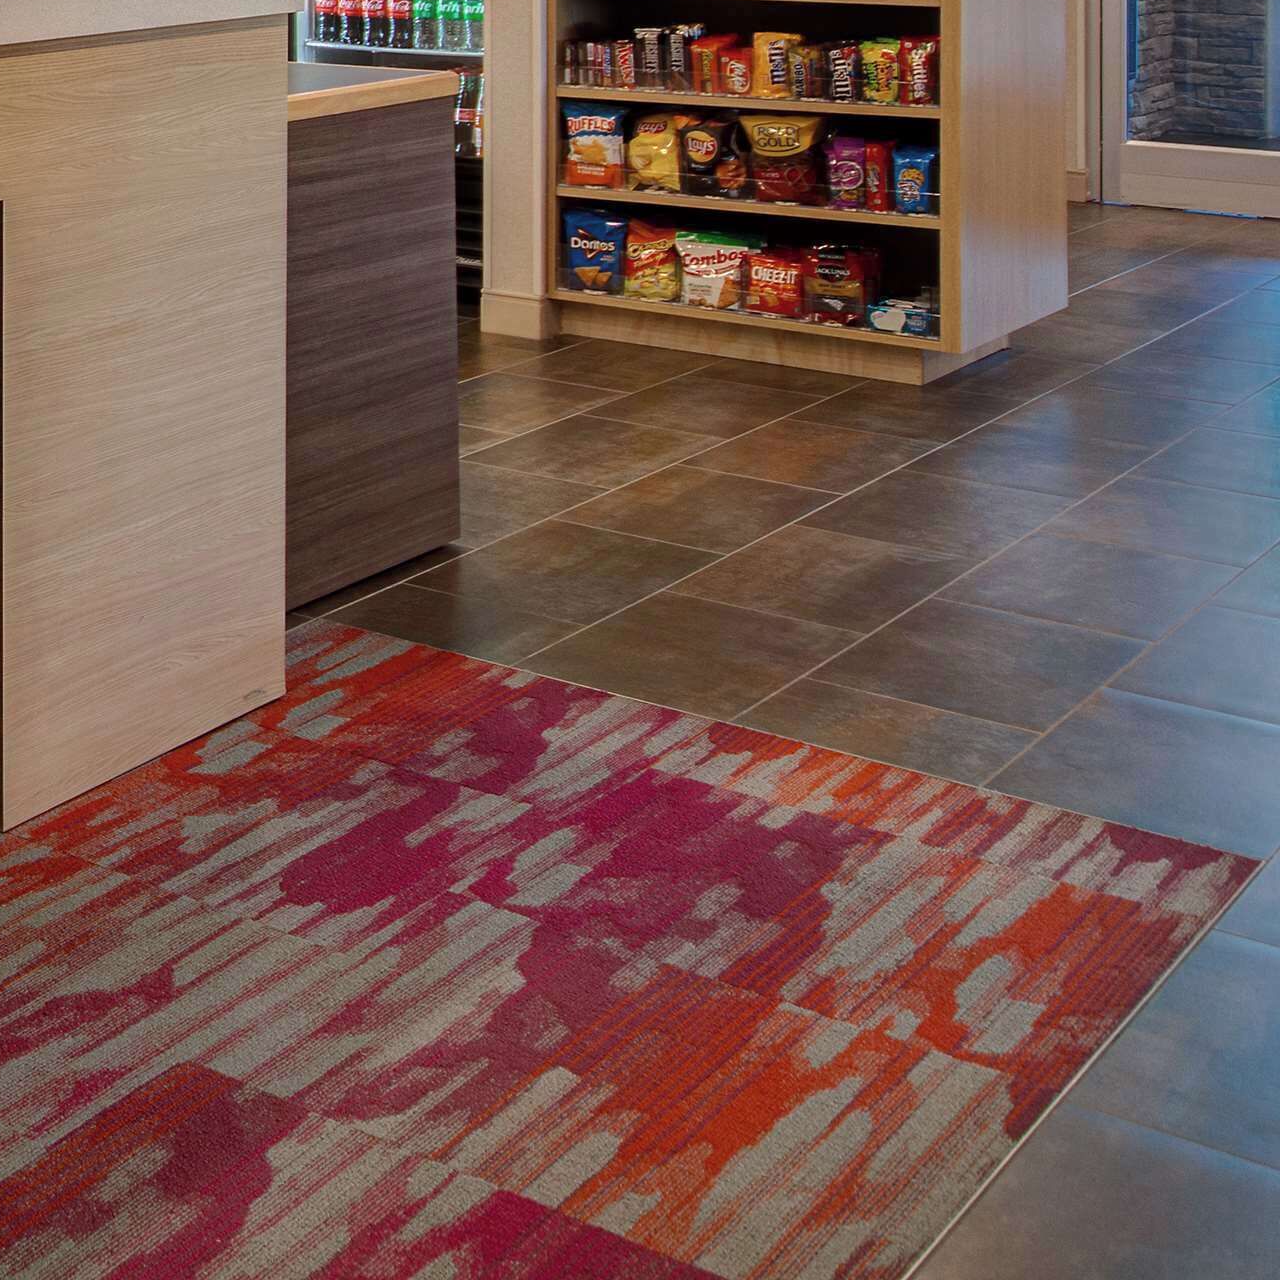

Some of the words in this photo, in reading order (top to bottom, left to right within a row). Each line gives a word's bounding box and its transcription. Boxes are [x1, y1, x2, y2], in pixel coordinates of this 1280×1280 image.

[794, 64, 804, 96] HARIBO
[911, 49, 926, 98] Skittles
[567, 116, 616, 133] RUFFLES
[757, 137, 795, 148] GOLD
[570, 237, 615, 252] Doritos
[683, 249, 748, 267] Combos
